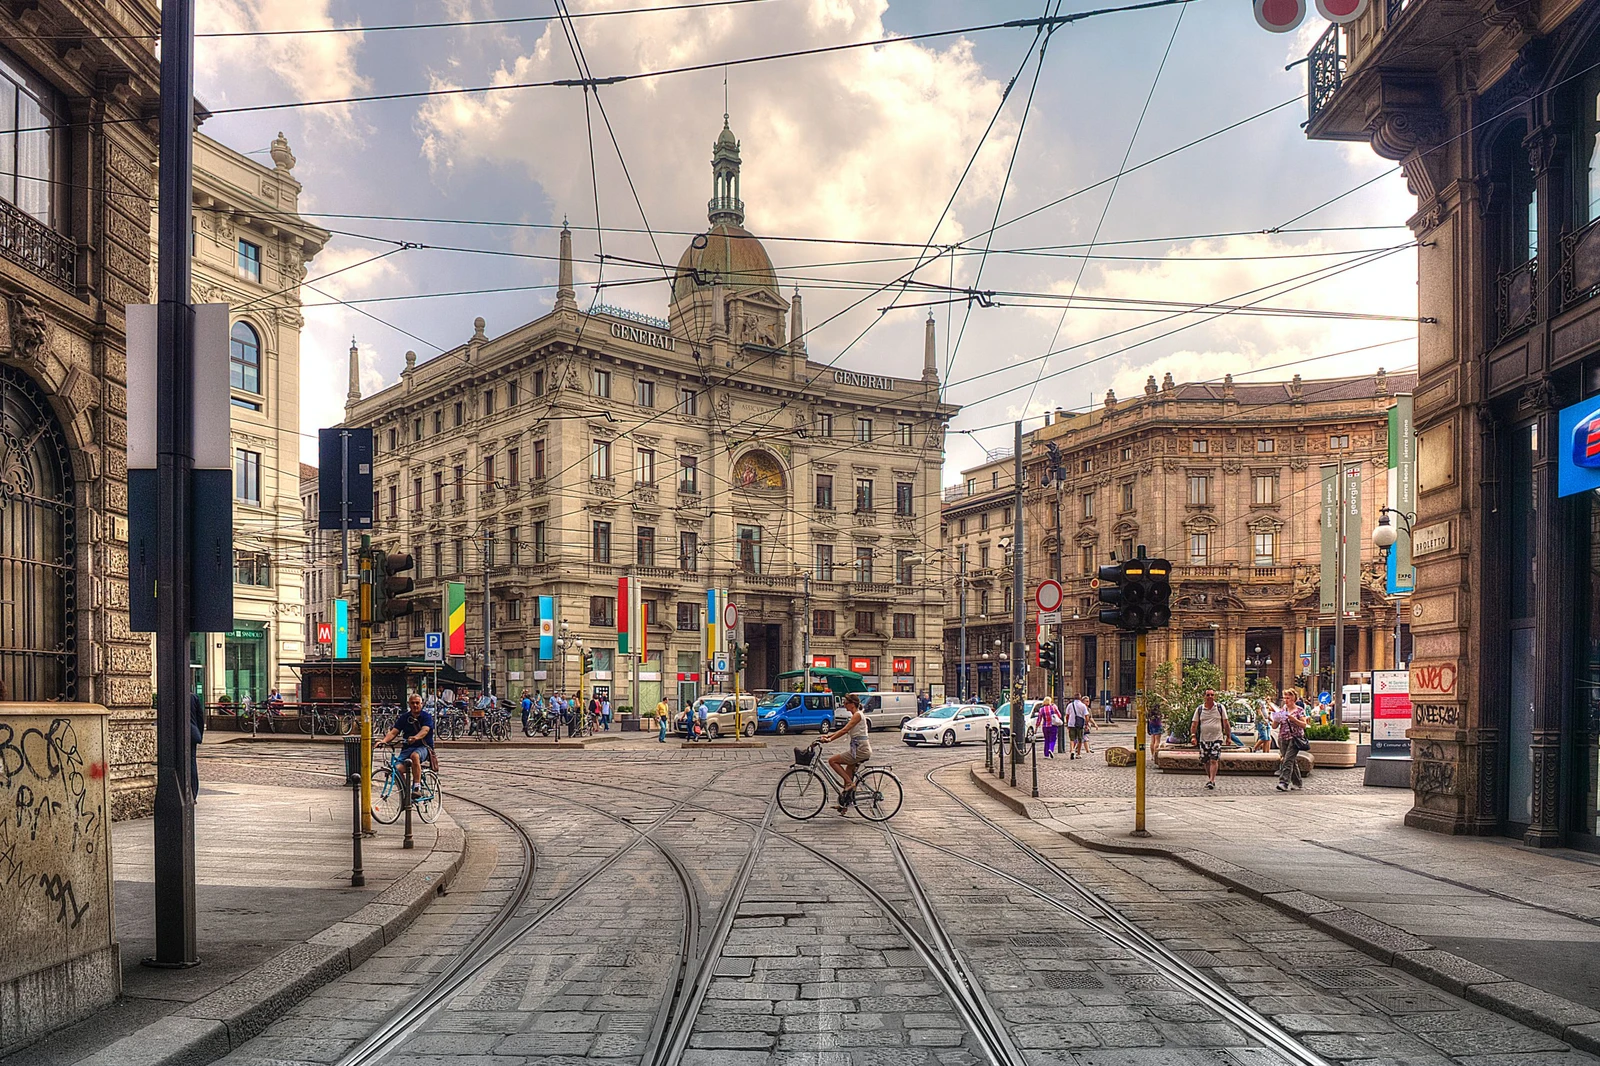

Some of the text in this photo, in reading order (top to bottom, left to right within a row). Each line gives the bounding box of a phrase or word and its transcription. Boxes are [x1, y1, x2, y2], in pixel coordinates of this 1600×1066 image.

[611, 322, 676, 352] GENERALI
[834, 370, 894, 391] GENERALI
[1349, 482, 1358, 515] georgia
[1416, 536, 1446, 551] BROLETTO
[319, 627, 331, 640] M
[430, 636, 438, 647] P
